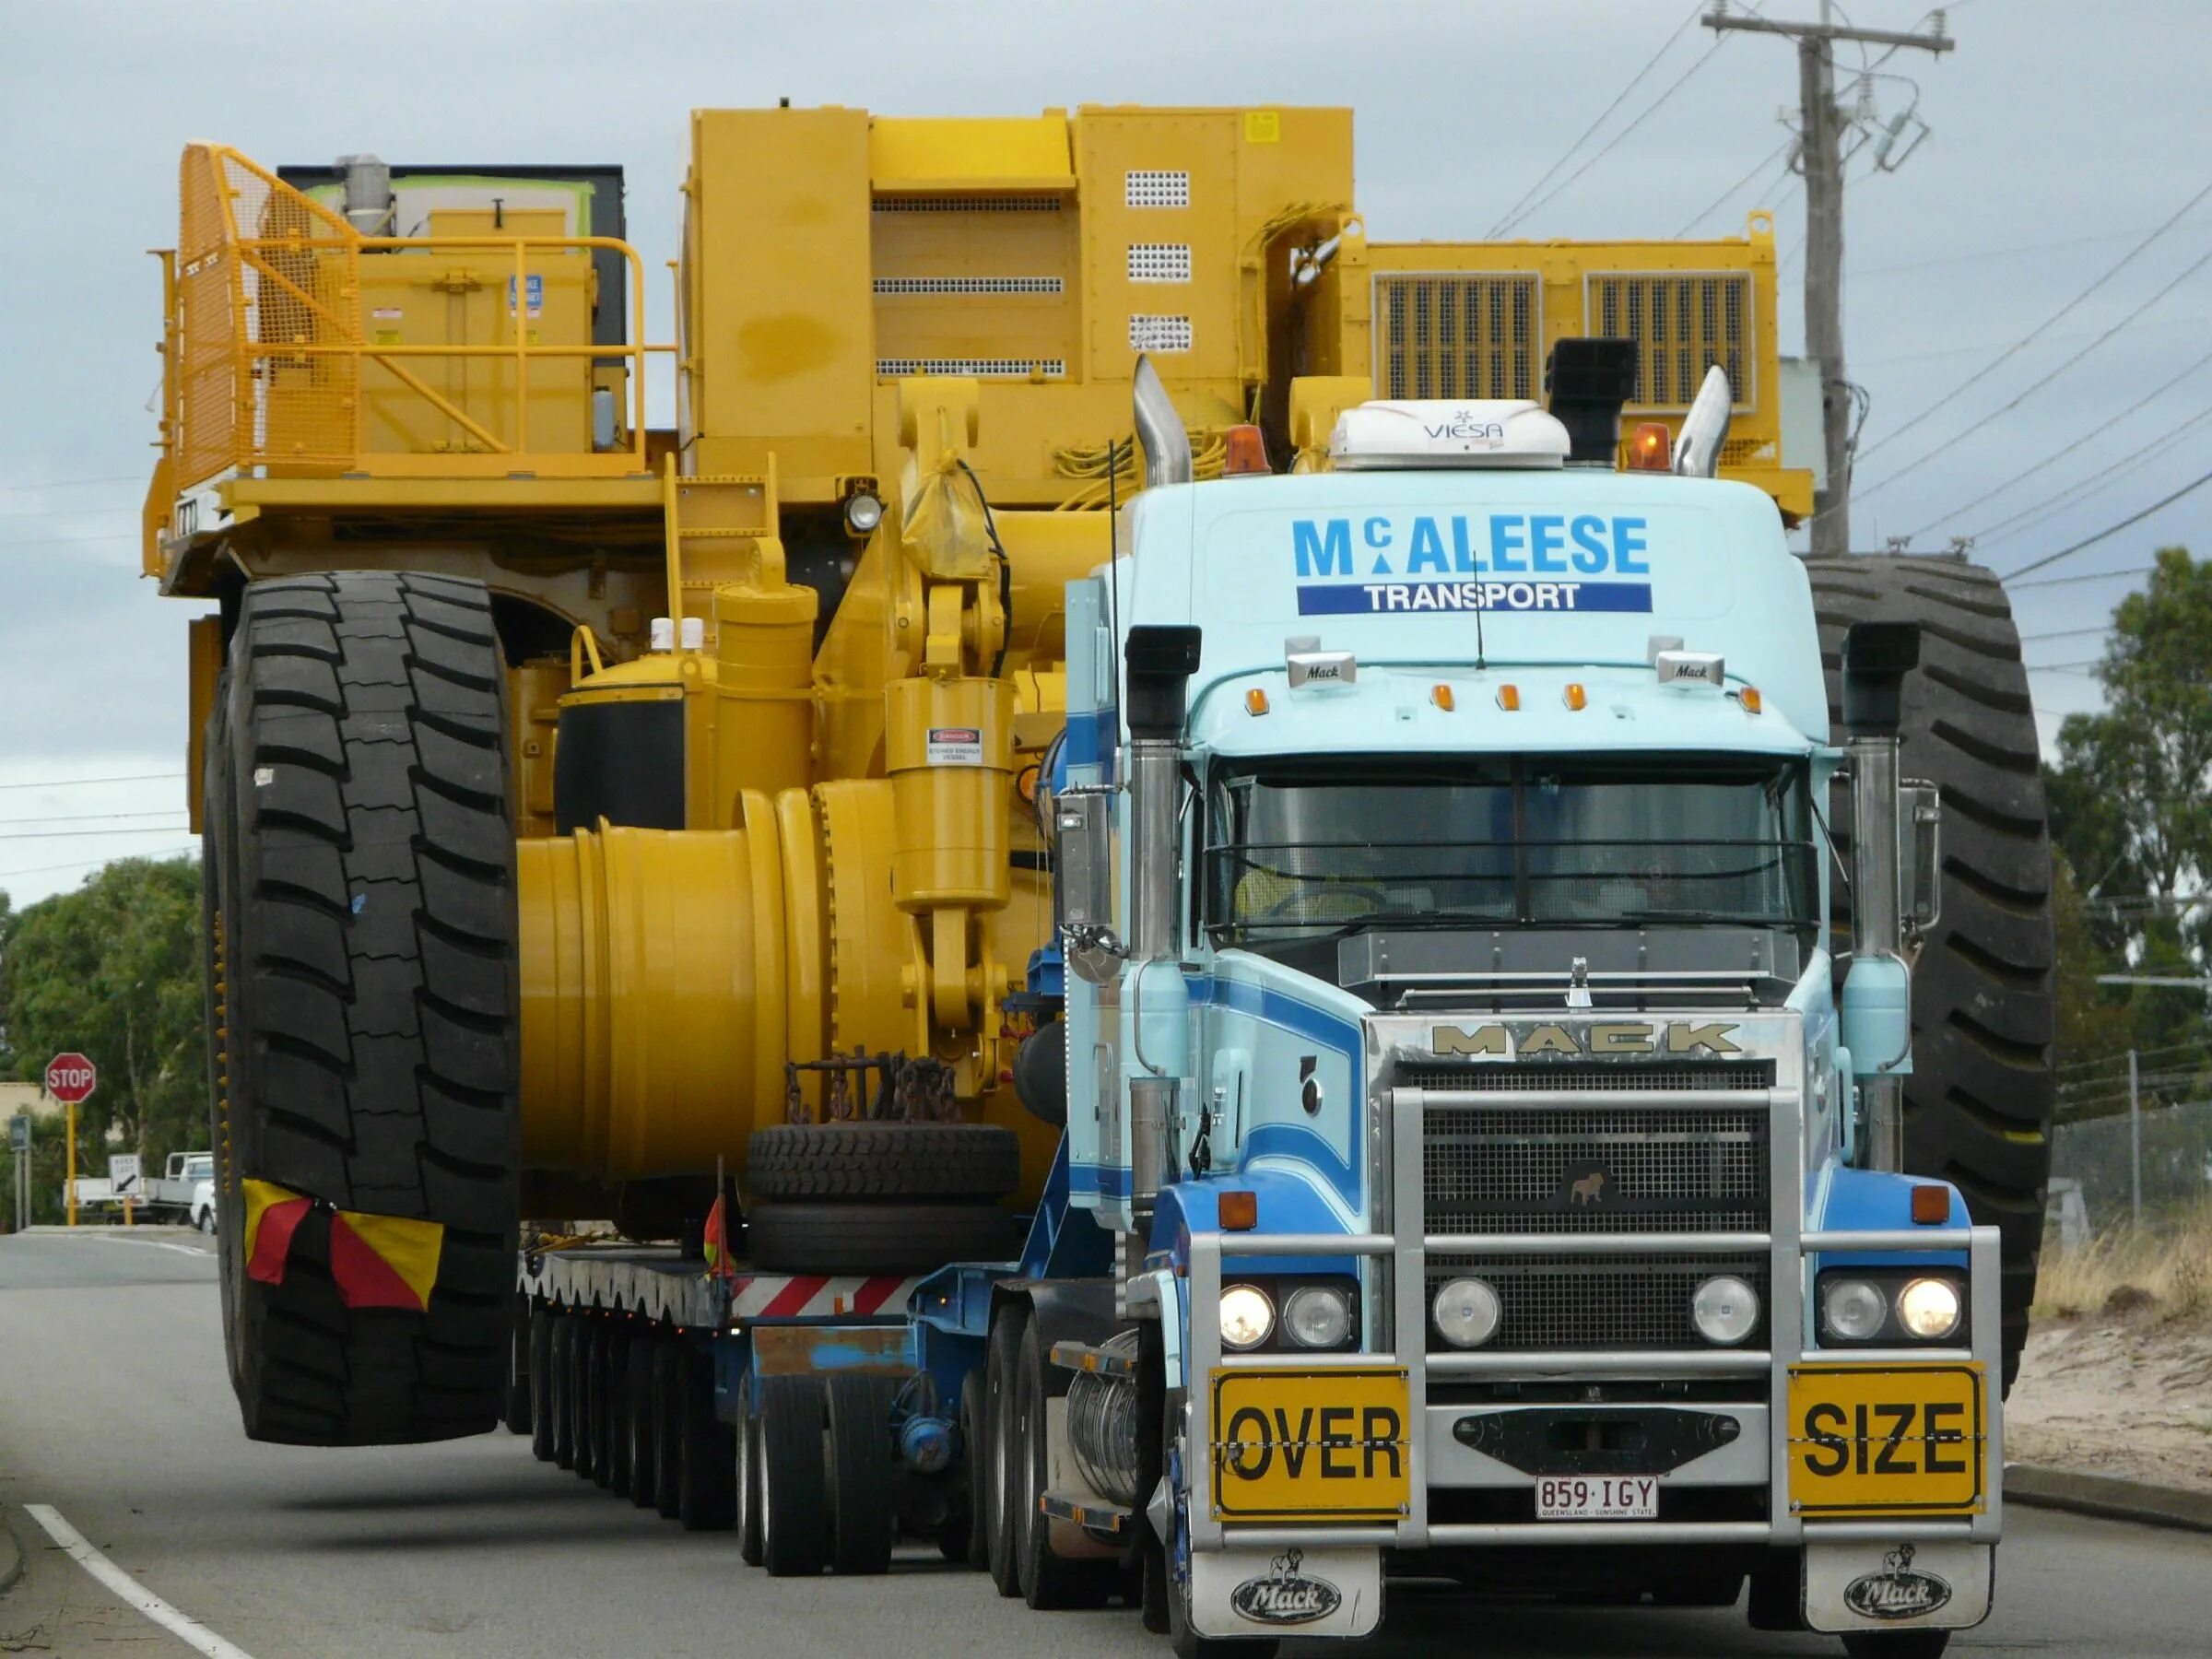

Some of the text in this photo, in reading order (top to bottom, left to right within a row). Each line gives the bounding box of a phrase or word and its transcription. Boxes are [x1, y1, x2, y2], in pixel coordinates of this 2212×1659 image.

[1424, 423, 1503, 439] VIESA
[1363, 582, 1581, 610] TRANSPORT
[1307, 665, 1339, 679] Mack
[1676, 665, 1708, 678] Mack
[1432, 1023, 1743, 1055] MACK
[49, 1068, 91, 1088] STOP
[1228, 1406, 1402, 1481] OVER
[1804, 1403, 1966, 1477] SIZE
[1247, 1583, 1323, 1611] Mack
[1862, 1578, 1933, 1607] Mack
